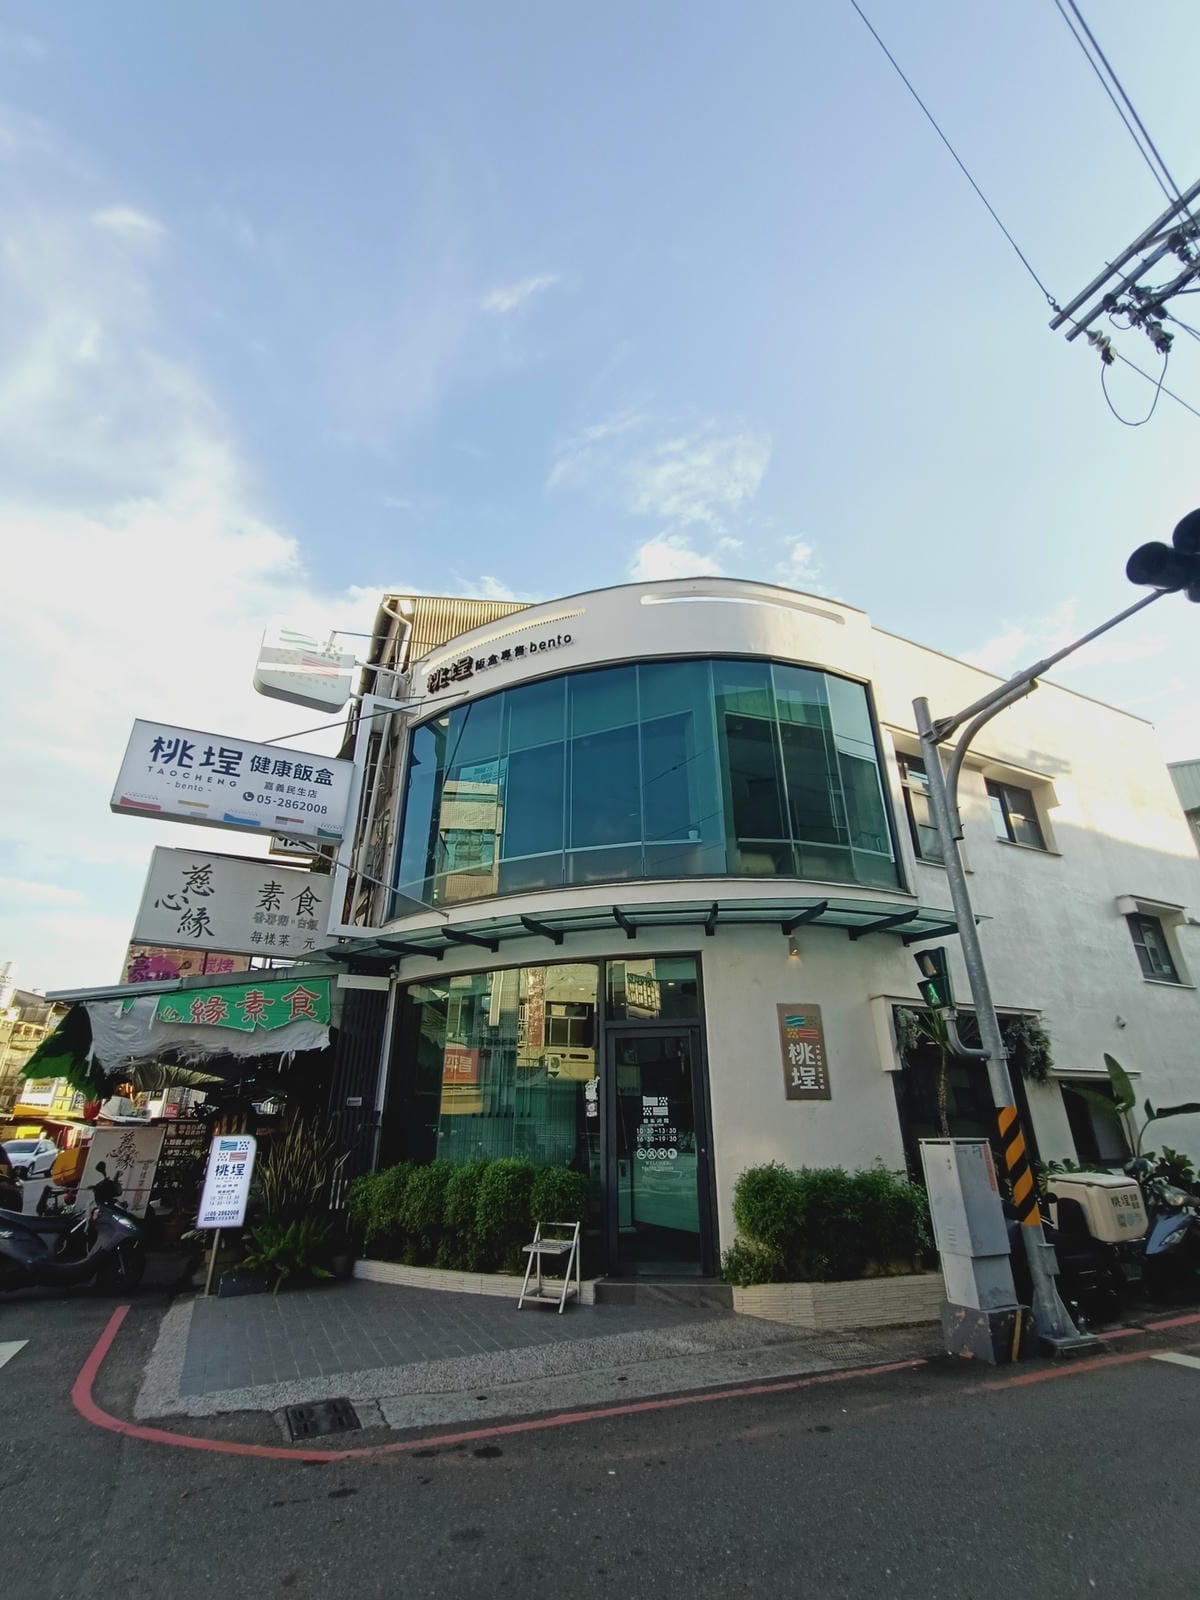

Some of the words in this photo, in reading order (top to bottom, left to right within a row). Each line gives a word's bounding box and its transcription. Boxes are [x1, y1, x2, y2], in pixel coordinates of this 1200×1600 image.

[530, 633, 572, 653] bento
[149, 736, 243, 777] 桃埕
[250, 754, 335, 786] 健康飯盒
[147, 765, 237, 787] TAOCHENG
[263, 781, 318, 799] 嘉義民生店
[257, 793, 328, 815] 05-2862008
[256, 880, 322, 917] 素食
[250, 930, 290, 948] 每樣菜
[303, 938, 316, 951] 元
[788, 1042, 819, 1090] 桃埕
[215, 1163, 246, 1176] 桃埕
